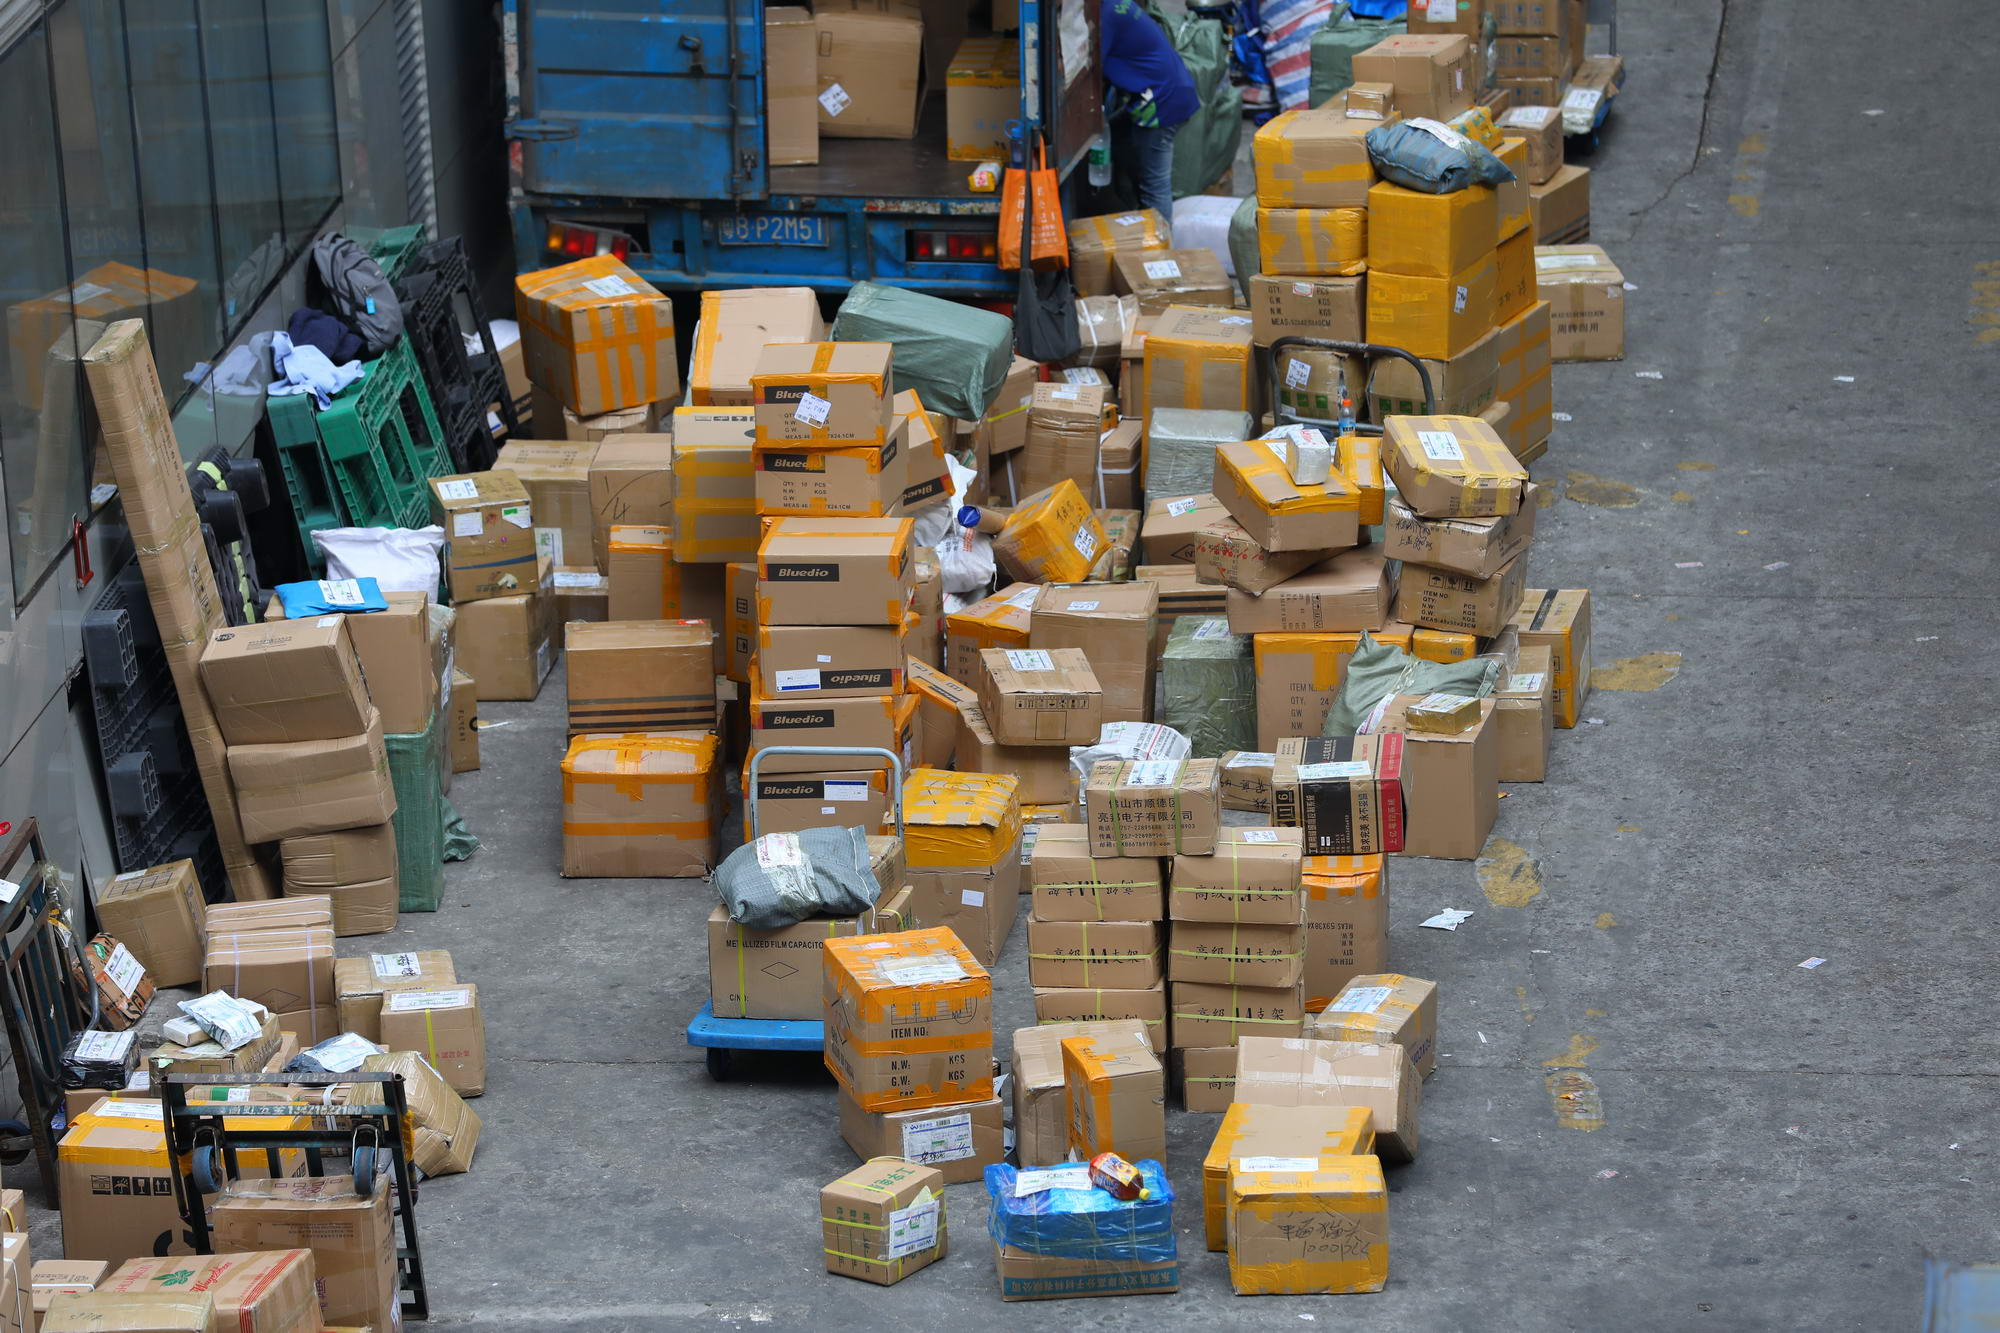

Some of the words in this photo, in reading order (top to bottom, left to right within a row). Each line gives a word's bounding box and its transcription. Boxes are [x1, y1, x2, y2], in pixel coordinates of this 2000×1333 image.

[756, 217, 822, 241] P2M51
[779, 568, 829, 577] Bluedio
[831, 673, 881, 683] Bluedio
[1290, 684, 1309, 692] ITEM
[1320, 698, 1329, 706] 24
[773, 714, 824, 725] Bluedio
[763, 785, 814, 795] Bluedio
[891, 1029, 912, 1039] ITEM
[913, 1027, 929, 1037] NO:
[891, 1060, 911, 1071] N.W:
[949, 1054, 965, 1064] KGS
[891, 1076, 911, 1086] G.W:
[948, 1070, 965, 1080] KGS
